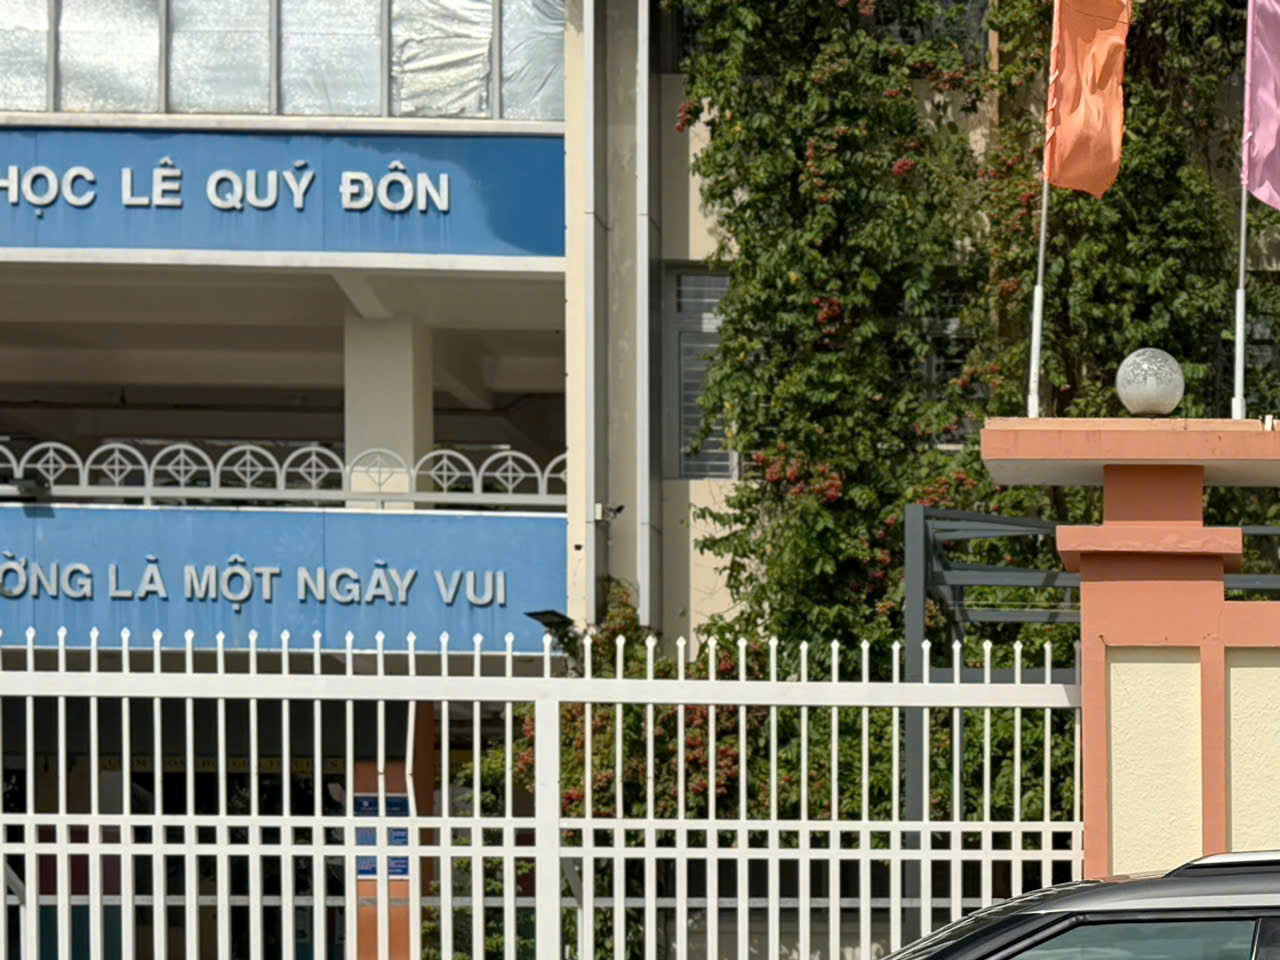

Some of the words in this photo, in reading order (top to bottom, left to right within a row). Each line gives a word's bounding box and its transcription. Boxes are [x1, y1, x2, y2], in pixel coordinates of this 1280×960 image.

[0, 165, 97, 218] HỌC
[121, 156, 183, 207] LÊ
[206, 160, 316, 211] QUÝ
[339, 160, 450, 212] ĐÔN
[108, 554, 169, 601] LÀ
[184, 554, 281, 613] MỘT
[296, 558, 417, 605] NGÀY
[434, 570, 507, 607] VUI
